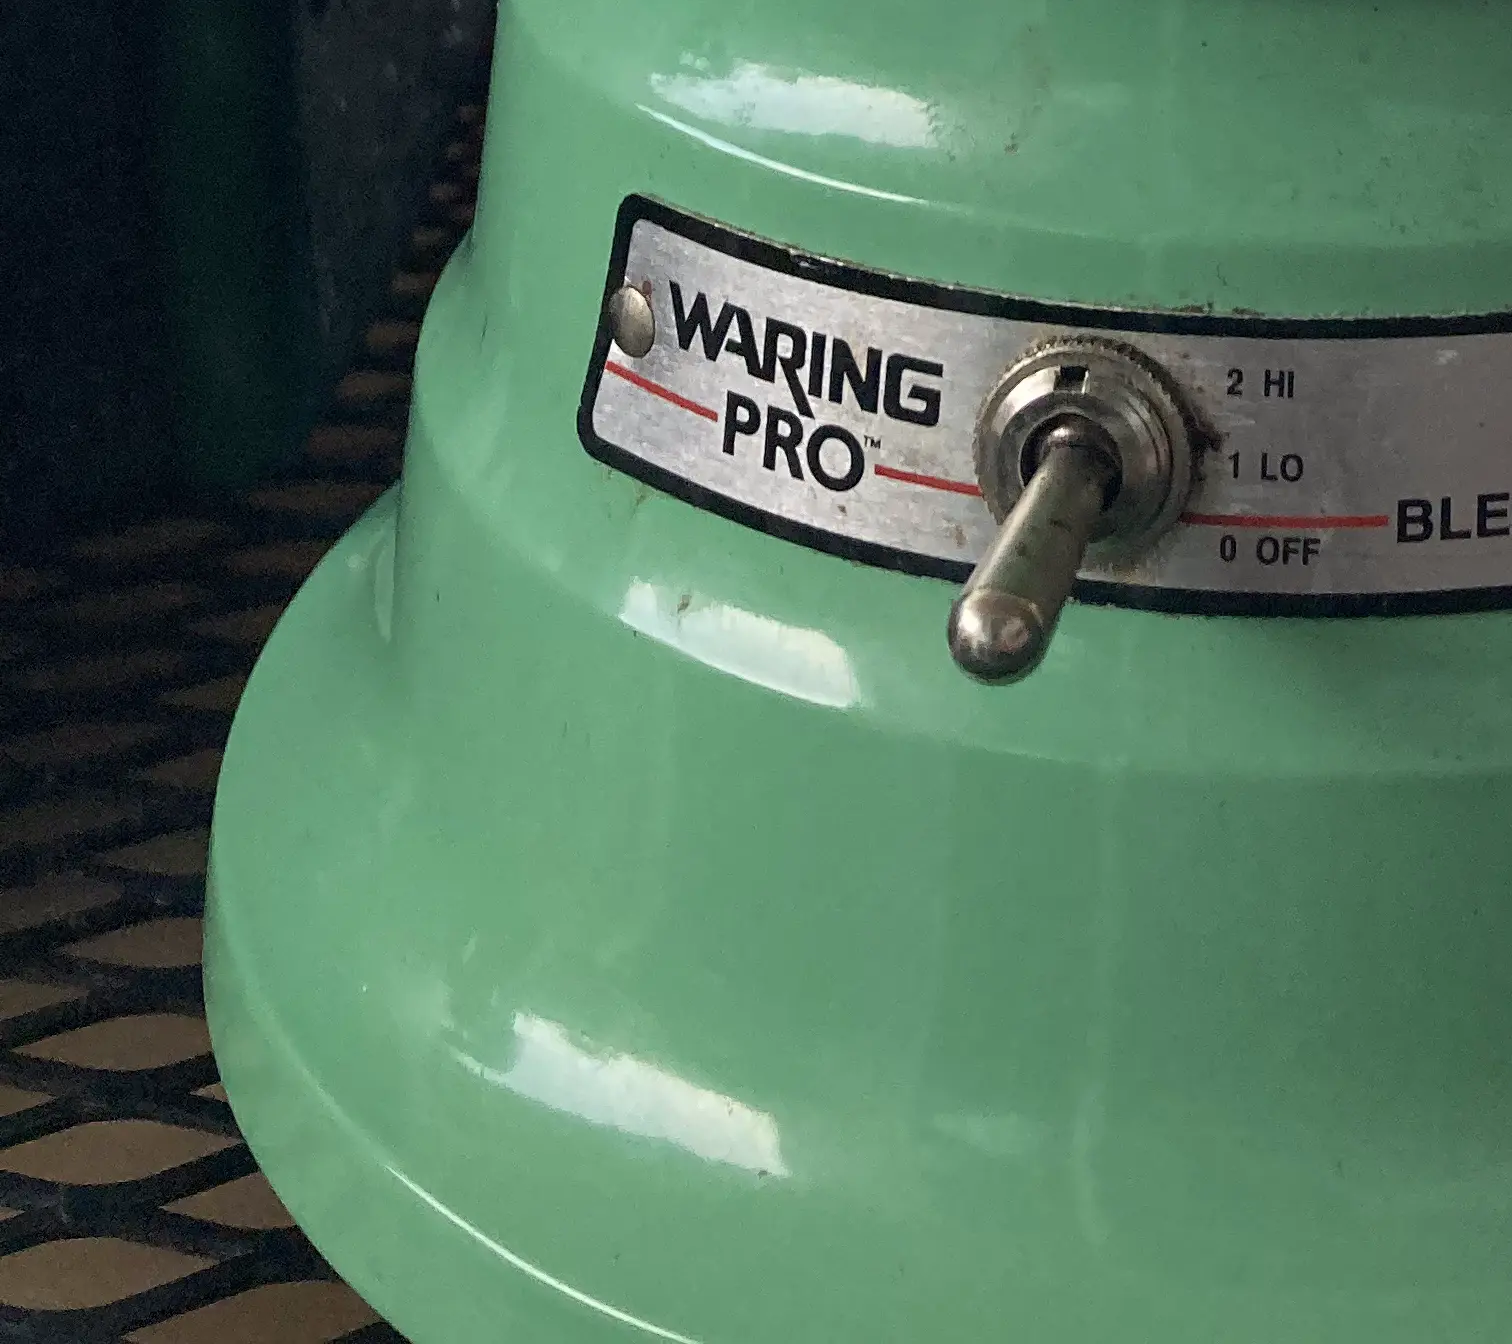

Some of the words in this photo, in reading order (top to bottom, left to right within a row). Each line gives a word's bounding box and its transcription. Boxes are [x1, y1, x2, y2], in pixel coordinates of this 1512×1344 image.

[669, 279, 944, 427] WARING
[1226, 368, 1245, 398] 2
[1263, 369, 1295, 399] HI
[722, 389, 865, 492] PRO
[1228, 449, 1241, 480] 1
[1260, 451, 1305, 483] LO
[1219, 534, 1238, 563] 0
[1256, 535, 1321, 566] OFF
